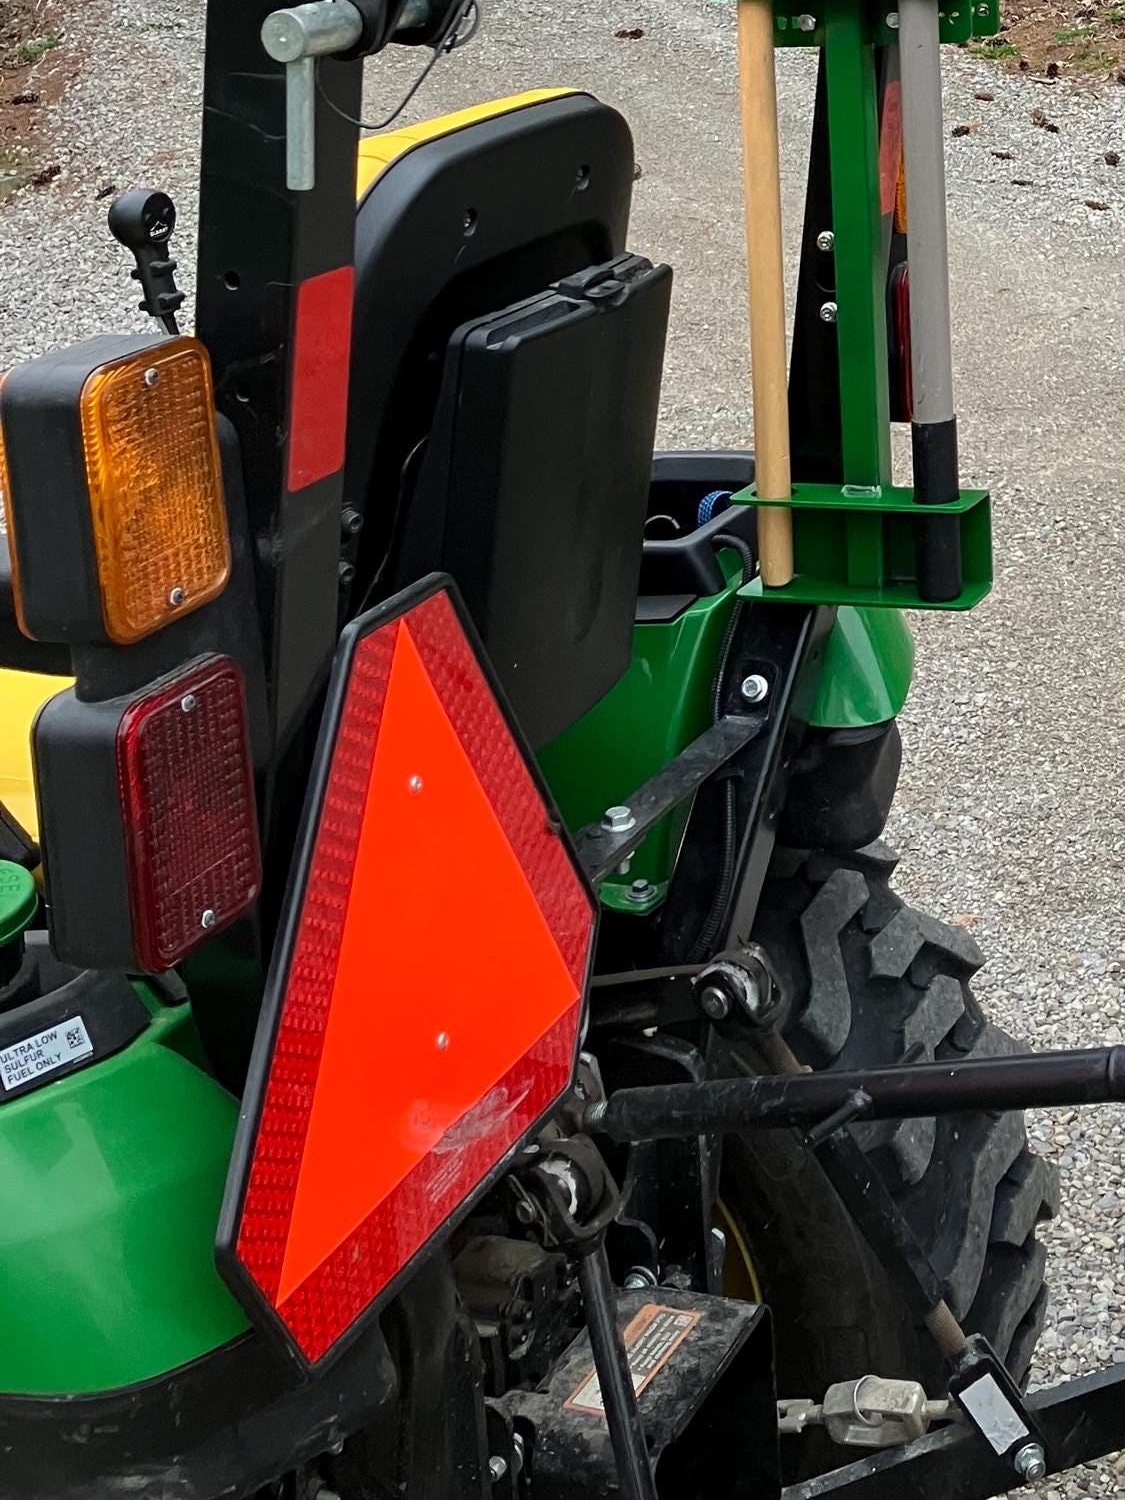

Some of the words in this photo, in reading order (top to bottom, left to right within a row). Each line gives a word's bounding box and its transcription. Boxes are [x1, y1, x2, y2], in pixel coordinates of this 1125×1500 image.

[0, 1043, 35, 1064] ULTRA
[35, 1030, 58, 1048] LOW
[4, 1049, 45, 1074] SULFUR
[8, 1069, 34, 1084] FUEL
[36, 1052, 62, 1070] ONLY
